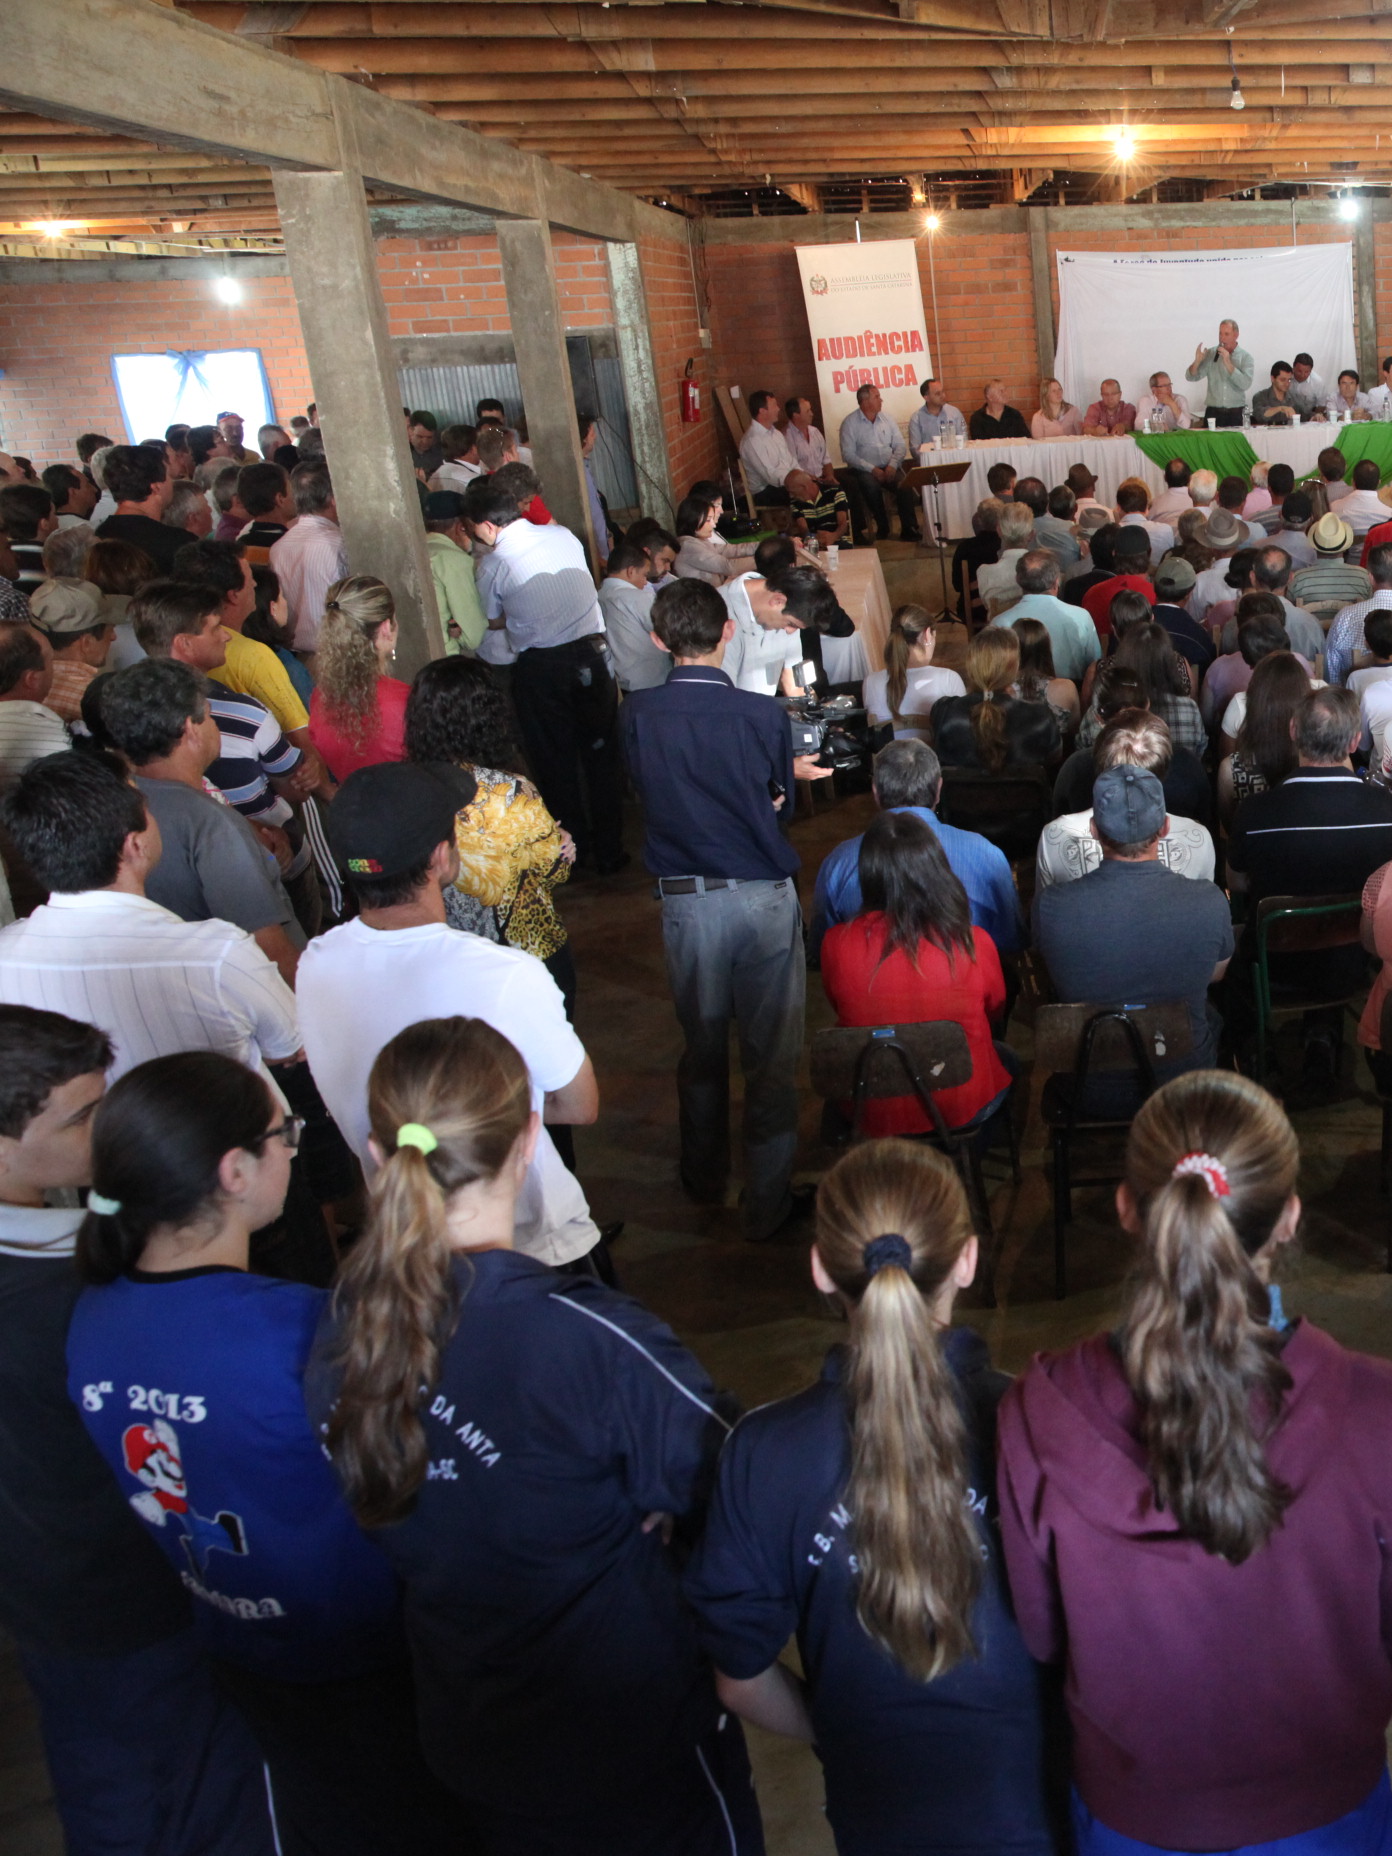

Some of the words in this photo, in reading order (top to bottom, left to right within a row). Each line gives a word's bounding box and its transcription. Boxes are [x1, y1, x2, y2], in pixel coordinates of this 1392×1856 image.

[831, 274, 870, 283] ASSEMBLEIA
[871, 272, 911, 281] LEGISLATIVA
[817, 330, 924, 361] AUDIÊNCIA
[832, 364, 918, 394] PÚBLICA
[127, 1384, 208, 1424] 2013
[429, 1394, 456, 1426] DA
[455, 1420, 502, 1469] ANTA
